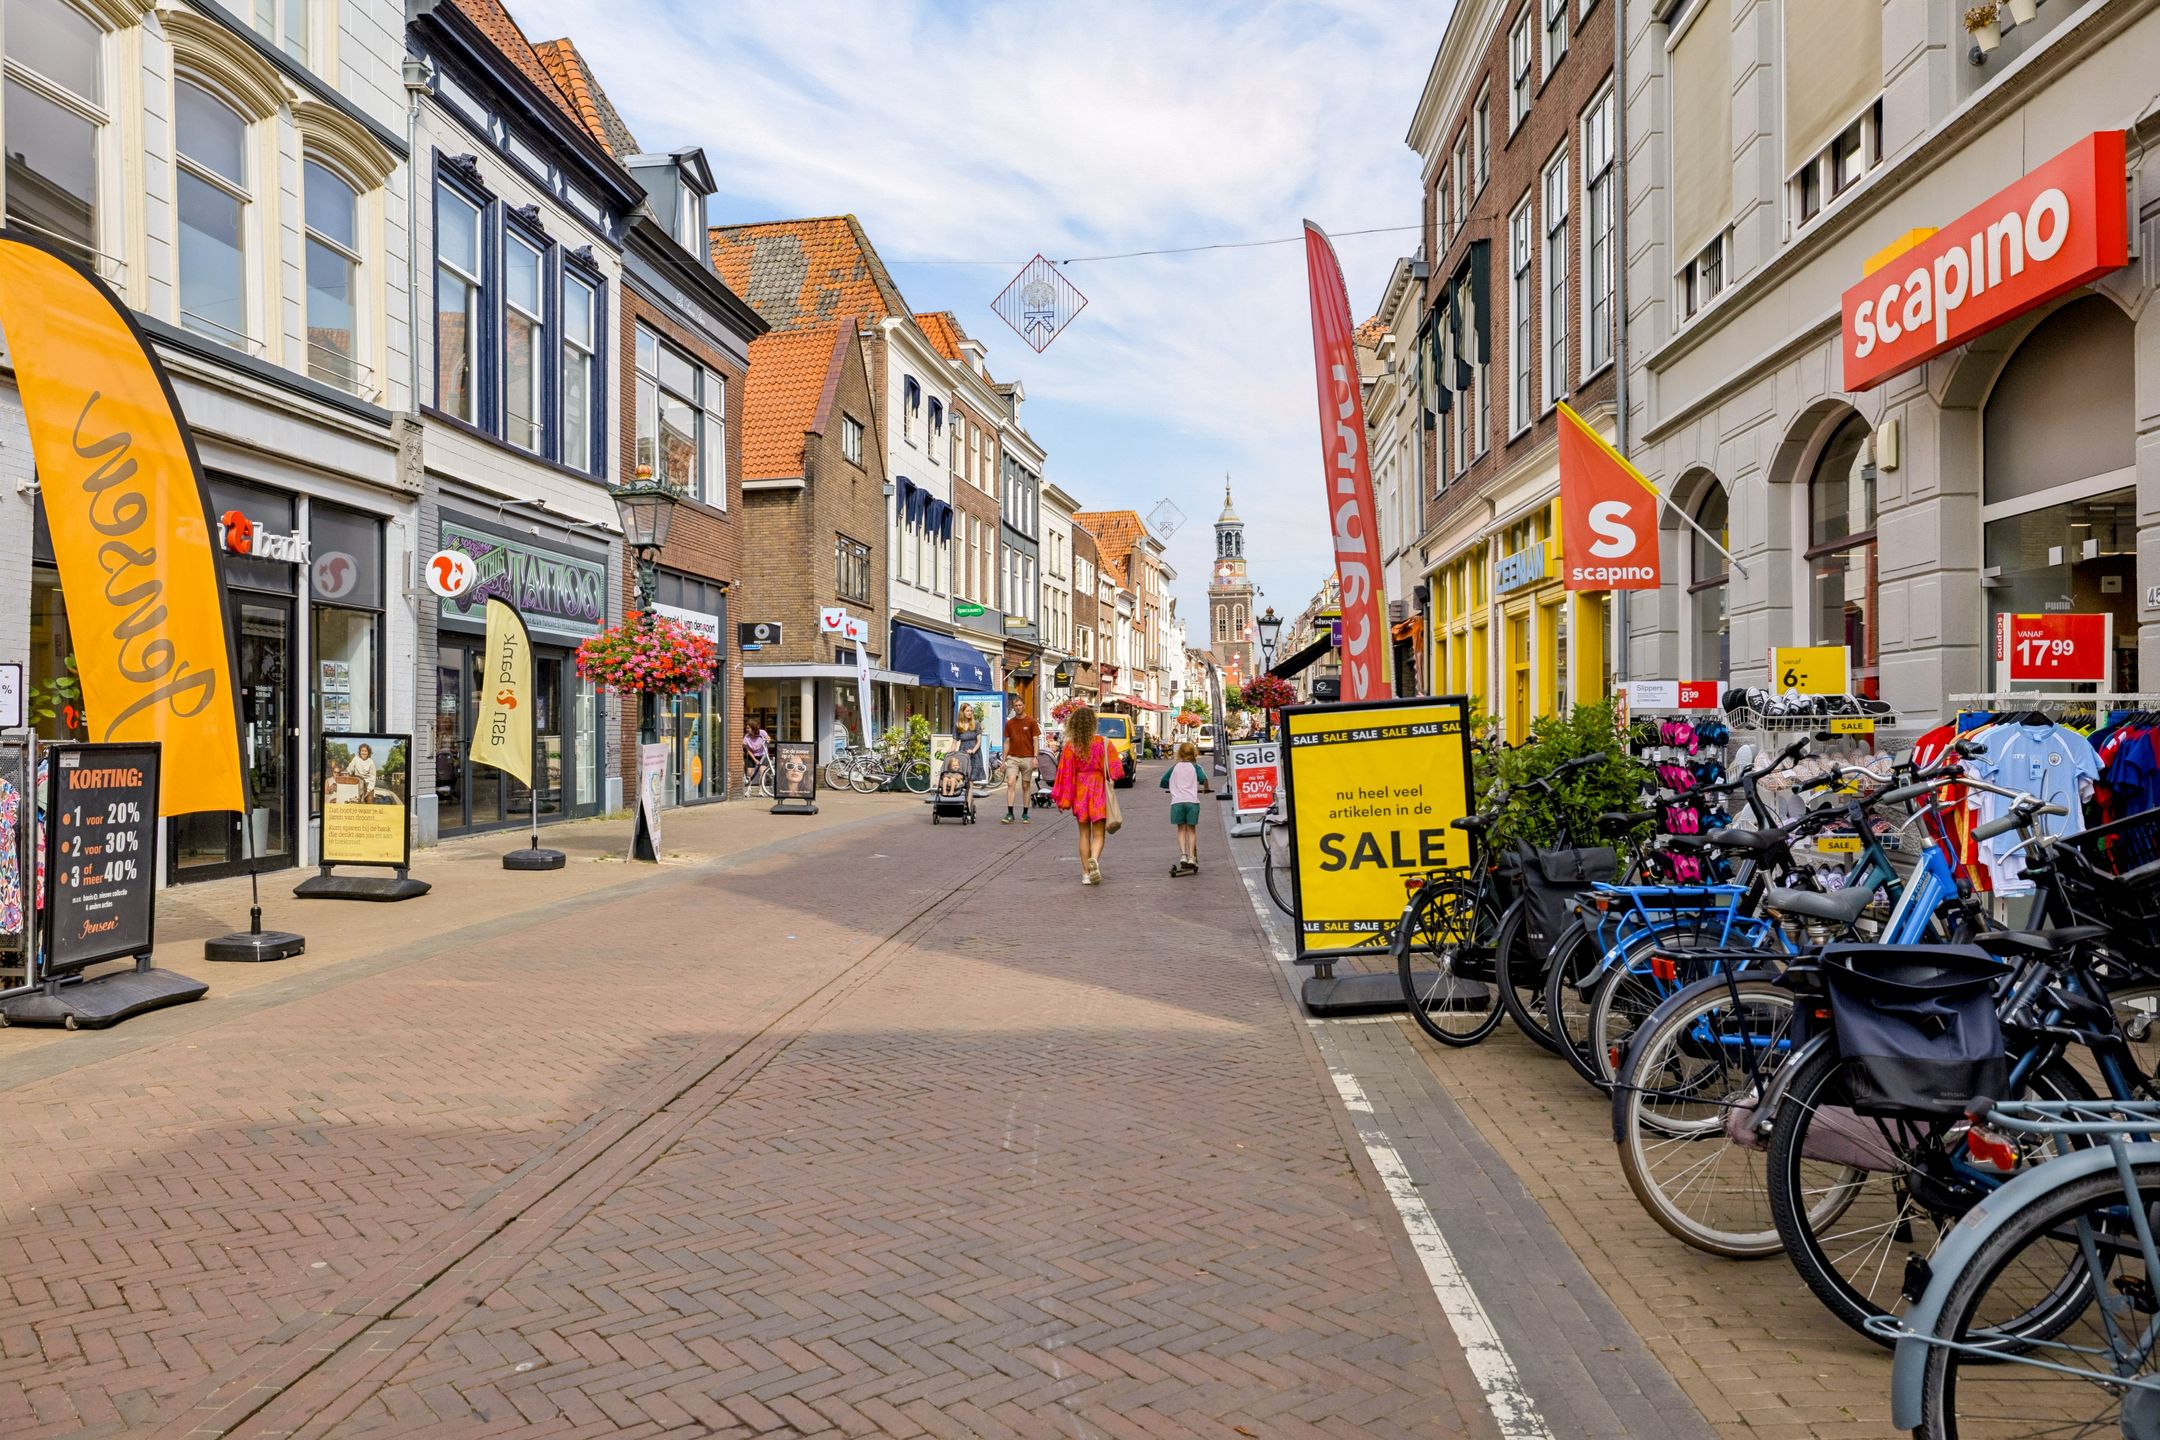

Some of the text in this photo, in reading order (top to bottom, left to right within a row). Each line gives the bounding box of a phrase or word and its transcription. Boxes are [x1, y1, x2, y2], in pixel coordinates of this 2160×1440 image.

[1854, 188, 2070, 359] scapino
[1588, 500, 1637, 559] S
[251, 521, 311, 565] bank
[1495, 541, 1545, 596] ZEEMAN
[1572, 566, 1655, 586] scapino
[505, 547, 601, 621] TATTOO
[2045, 601, 2071, 610] PUMA
[2017, 630, 2044, 638] VANAF
[1636, 684, 1664, 692] Slippers
[1293, 721, 1461, 745] SALE SALE SALE SALE SALE SAL
[1841, 722, 1863, 730] SALE
[1235, 747, 1276, 765] sale
[69, 767, 143, 790] KORTING:
[1242, 780, 1272, 793] 50%
[1336, 784, 1423, 800] nu heel veel
[74, 801, 140, 828] 1 voor 20%
[1329, 802, 1432, 819] artikelen in de
[71, 830, 139, 858] 2 voor 30%
[1319, 828, 1448, 872] SALE
[71, 858, 138, 888] 3 of meer 40%
[79, 915, 119, 939] Jensen
[1303, 922, 1320, 931] ALE
[1324, 922, 1349, 931] SALE
[1354, 922, 1379, 931] SALE
[1359, 935, 1389, 948] ALE
